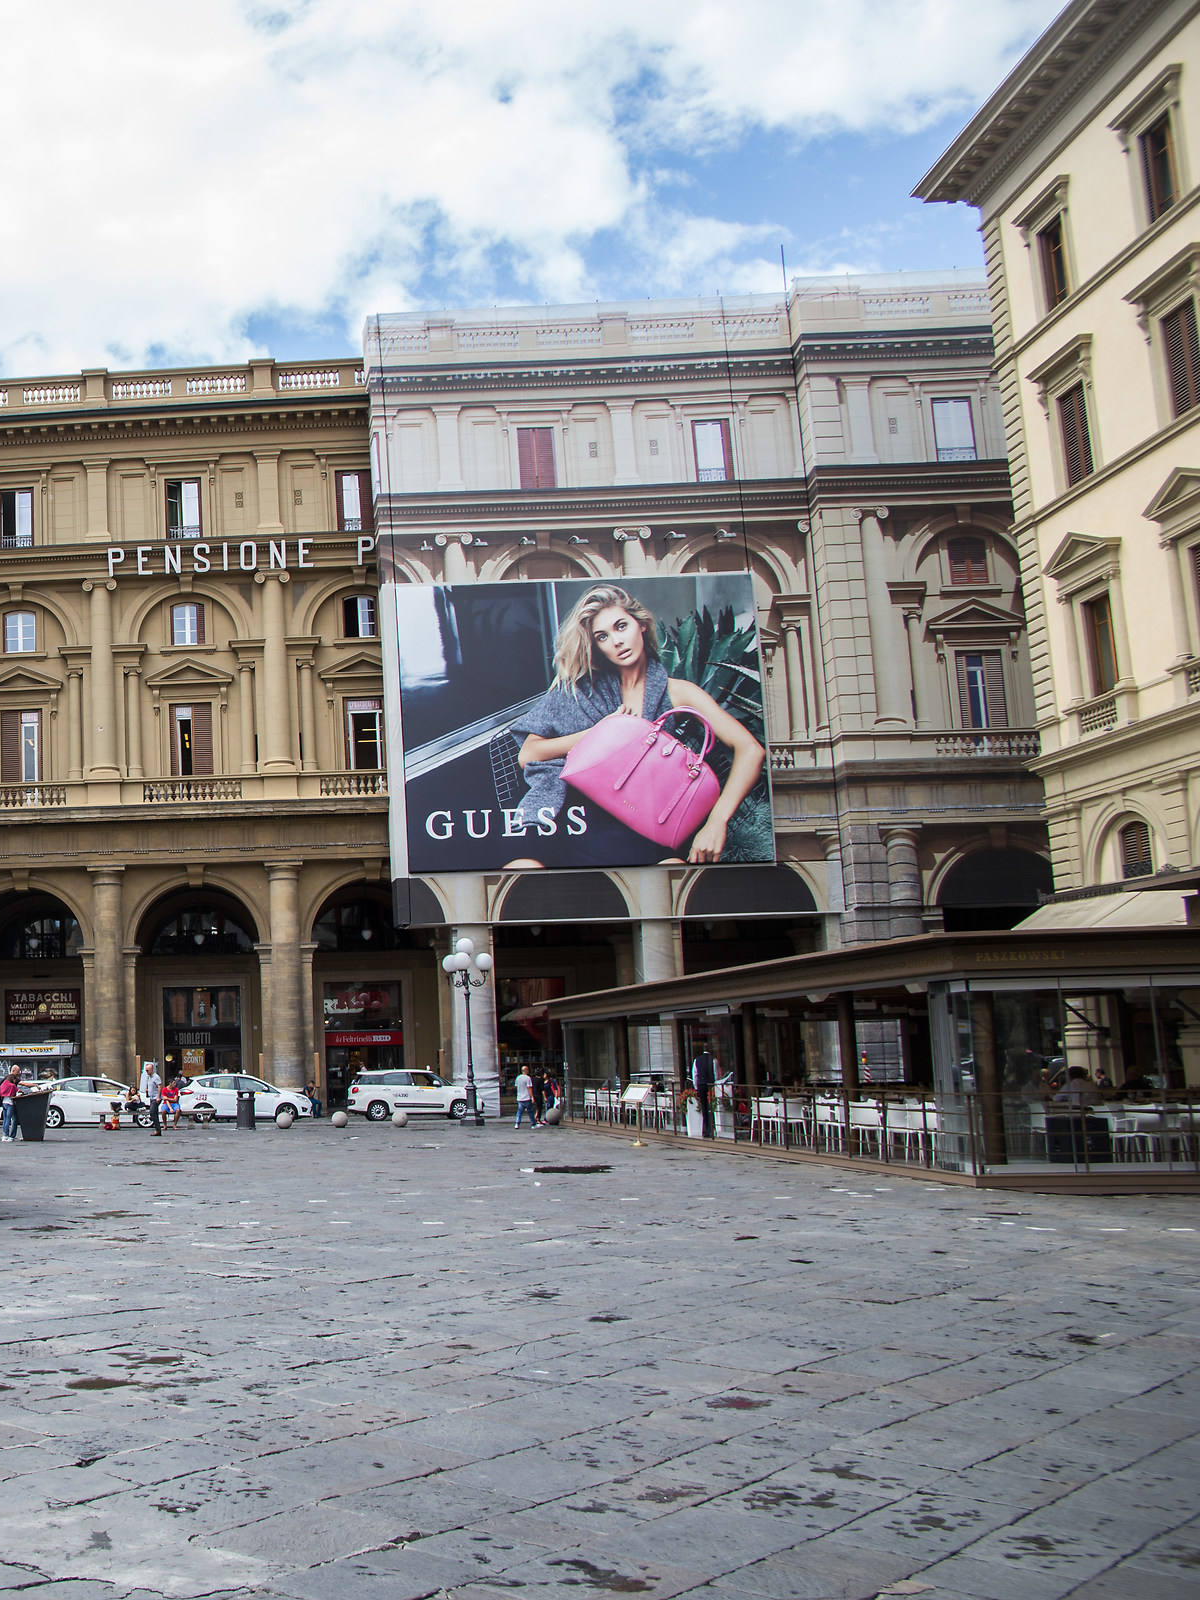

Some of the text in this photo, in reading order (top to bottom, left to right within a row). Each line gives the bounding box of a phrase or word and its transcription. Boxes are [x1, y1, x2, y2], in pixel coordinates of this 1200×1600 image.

[107, 538, 315, 577] PENSIONE
[425, 805, 588, 840] GUESS
[975, 950, 1066, 962] PASZKOWSKI
[13, 992, 72, 1002] TABACCHI
[183, 1056, 203, 1064] SCONTI
